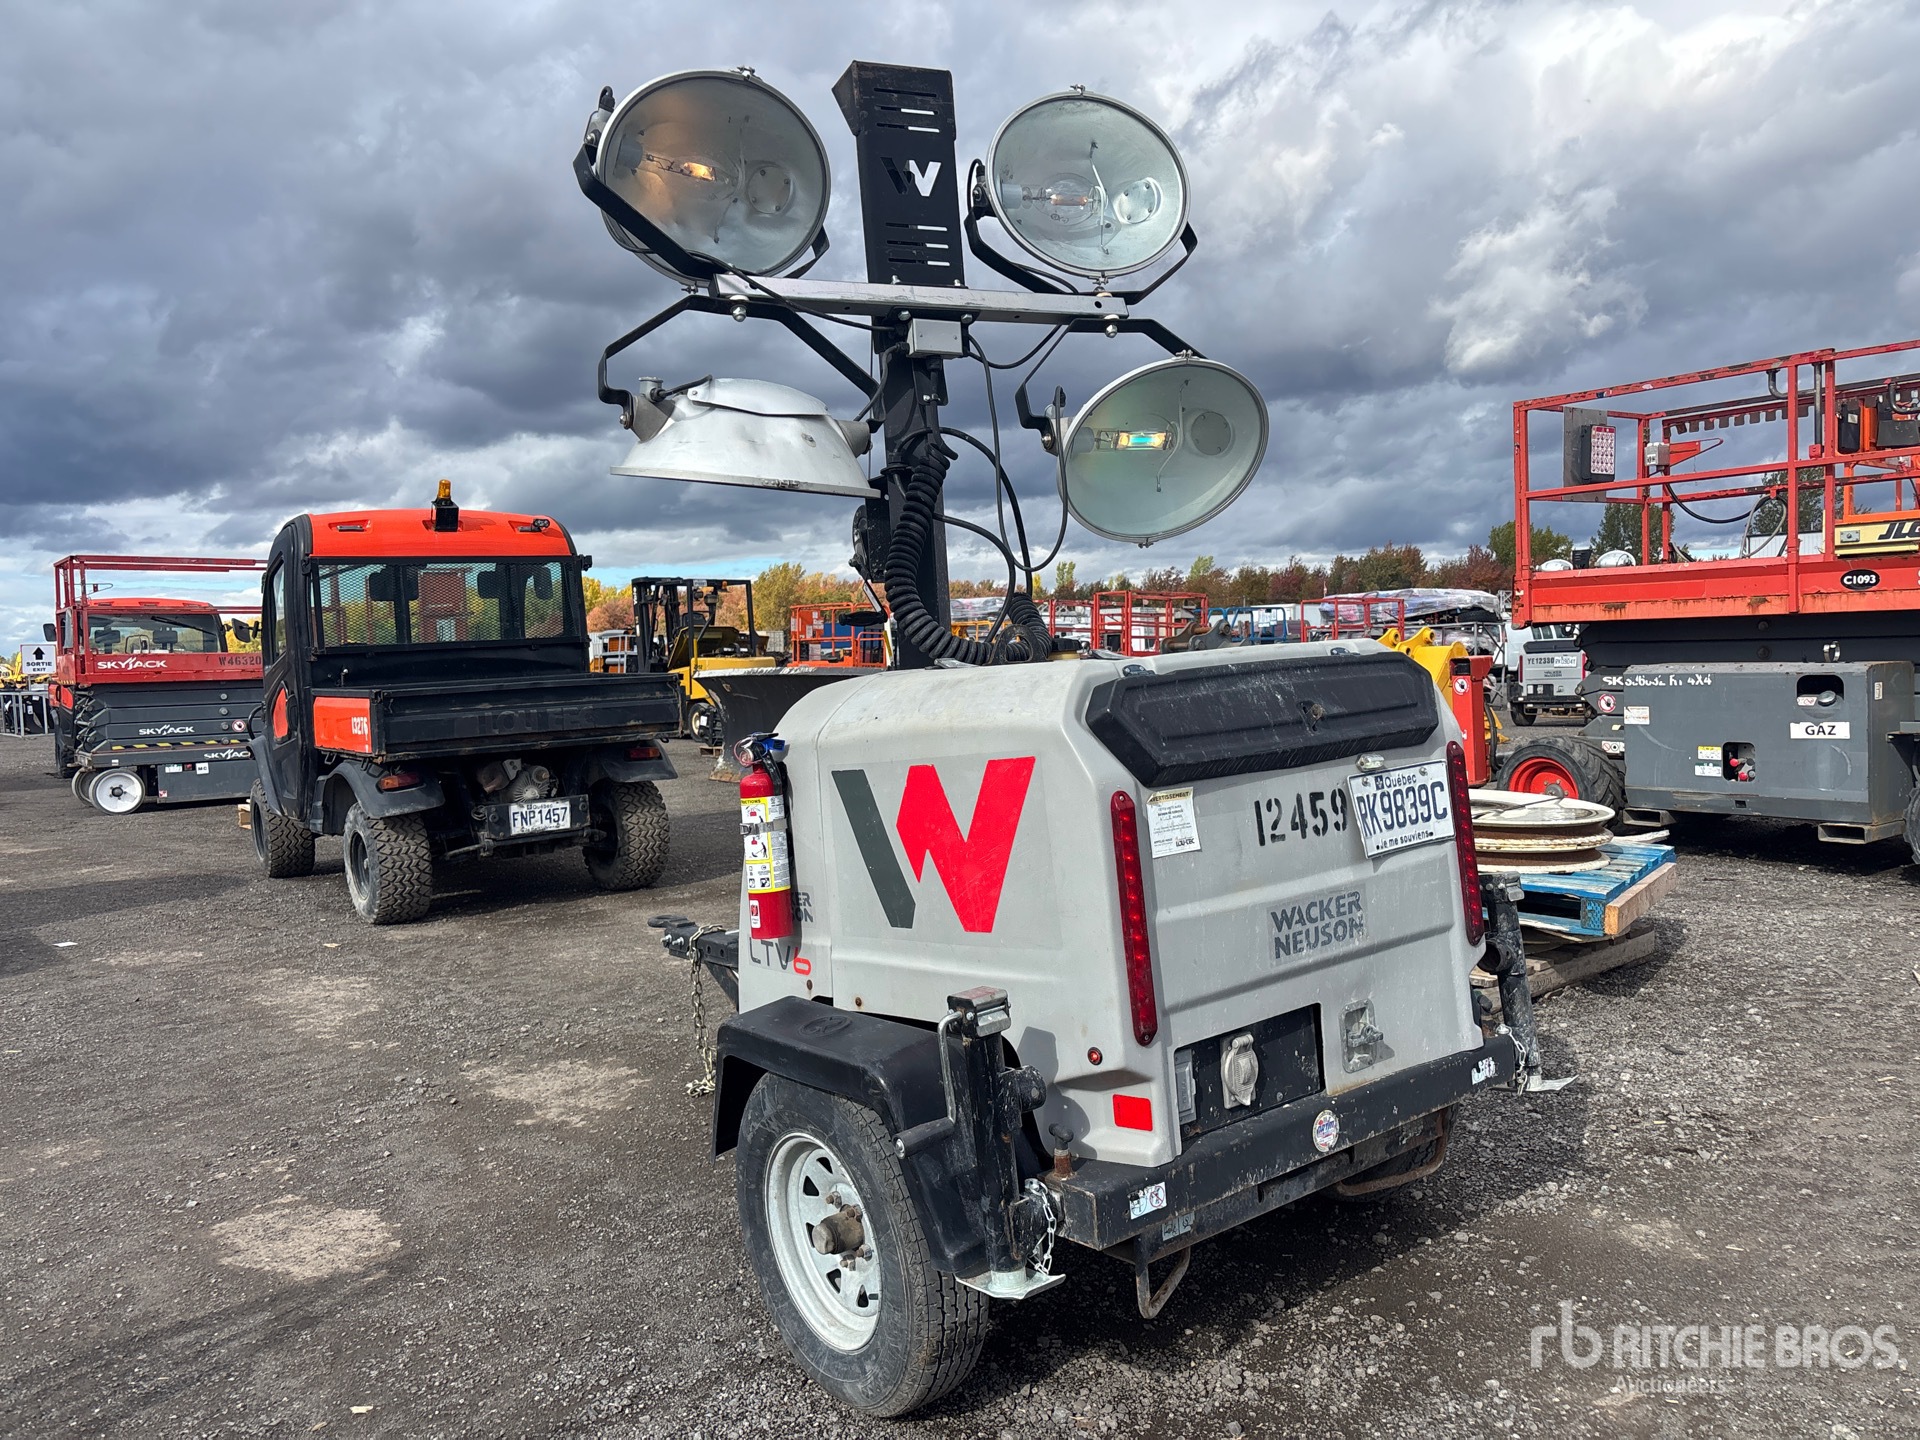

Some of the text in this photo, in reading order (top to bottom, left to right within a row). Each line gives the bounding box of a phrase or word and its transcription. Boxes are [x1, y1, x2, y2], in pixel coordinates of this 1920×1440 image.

[1843, 575, 1877, 585] C1093
[97, 657, 168, 670] SKYJACK
[138, 724, 196, 736] SKYJACK
[1805, 725, 1837, 736] GAZ
[1385, 773, 1417, 789] Québec
[512, 806, 568, 828] FNP1457
[1254, 788, 1347, 847] 12459
[1356, 781, 1448, 838] RK9839C
[1380, 831, 1430, 850] Je me souviens
[1270, 891, 1363, 933] WACKER
[1274, 915, 1365, 959] NEUSON
[749, 937, 812, 976] LTV6
